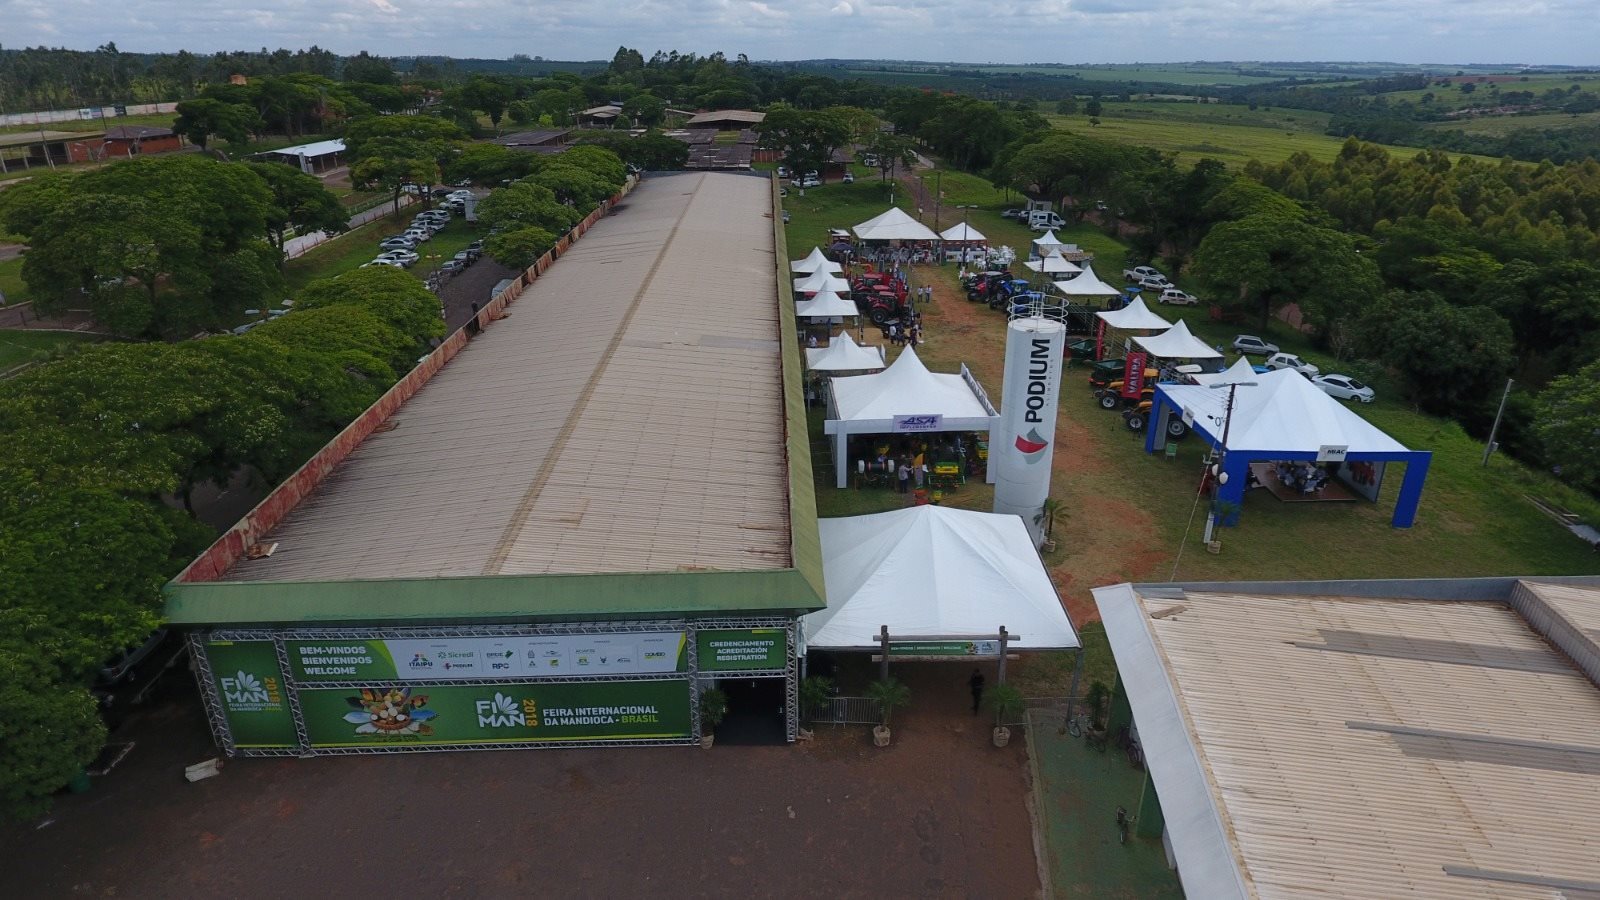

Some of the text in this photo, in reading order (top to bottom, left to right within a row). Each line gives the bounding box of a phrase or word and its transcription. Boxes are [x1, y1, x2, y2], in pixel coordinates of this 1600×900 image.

[1025, 339, 1050, 422] PODIUM
[1127, 357, 1141, 394] VALTRA
[299, 646, 366, 654] BEM-VINDOS
[709, 640, 774, 648] CREDENCIAMENTO
[302, 656, 372, 664] BIENVENIDOS
[304, 666, 356, 674] WELCOME
[264, 677, 280, 702] 2018
[225, 690, 270, 703] MAN
[523, 699, 538, 727] 2018
[543, 706, 658, 717] FEIRA INTERNACIONAL
[478, 713, 525, 728] MAN
[544, 718, 558, 726] DA
[560, 716, 614, 726] MANDIOCA
[621, 715, 659, 723] BRASIL
